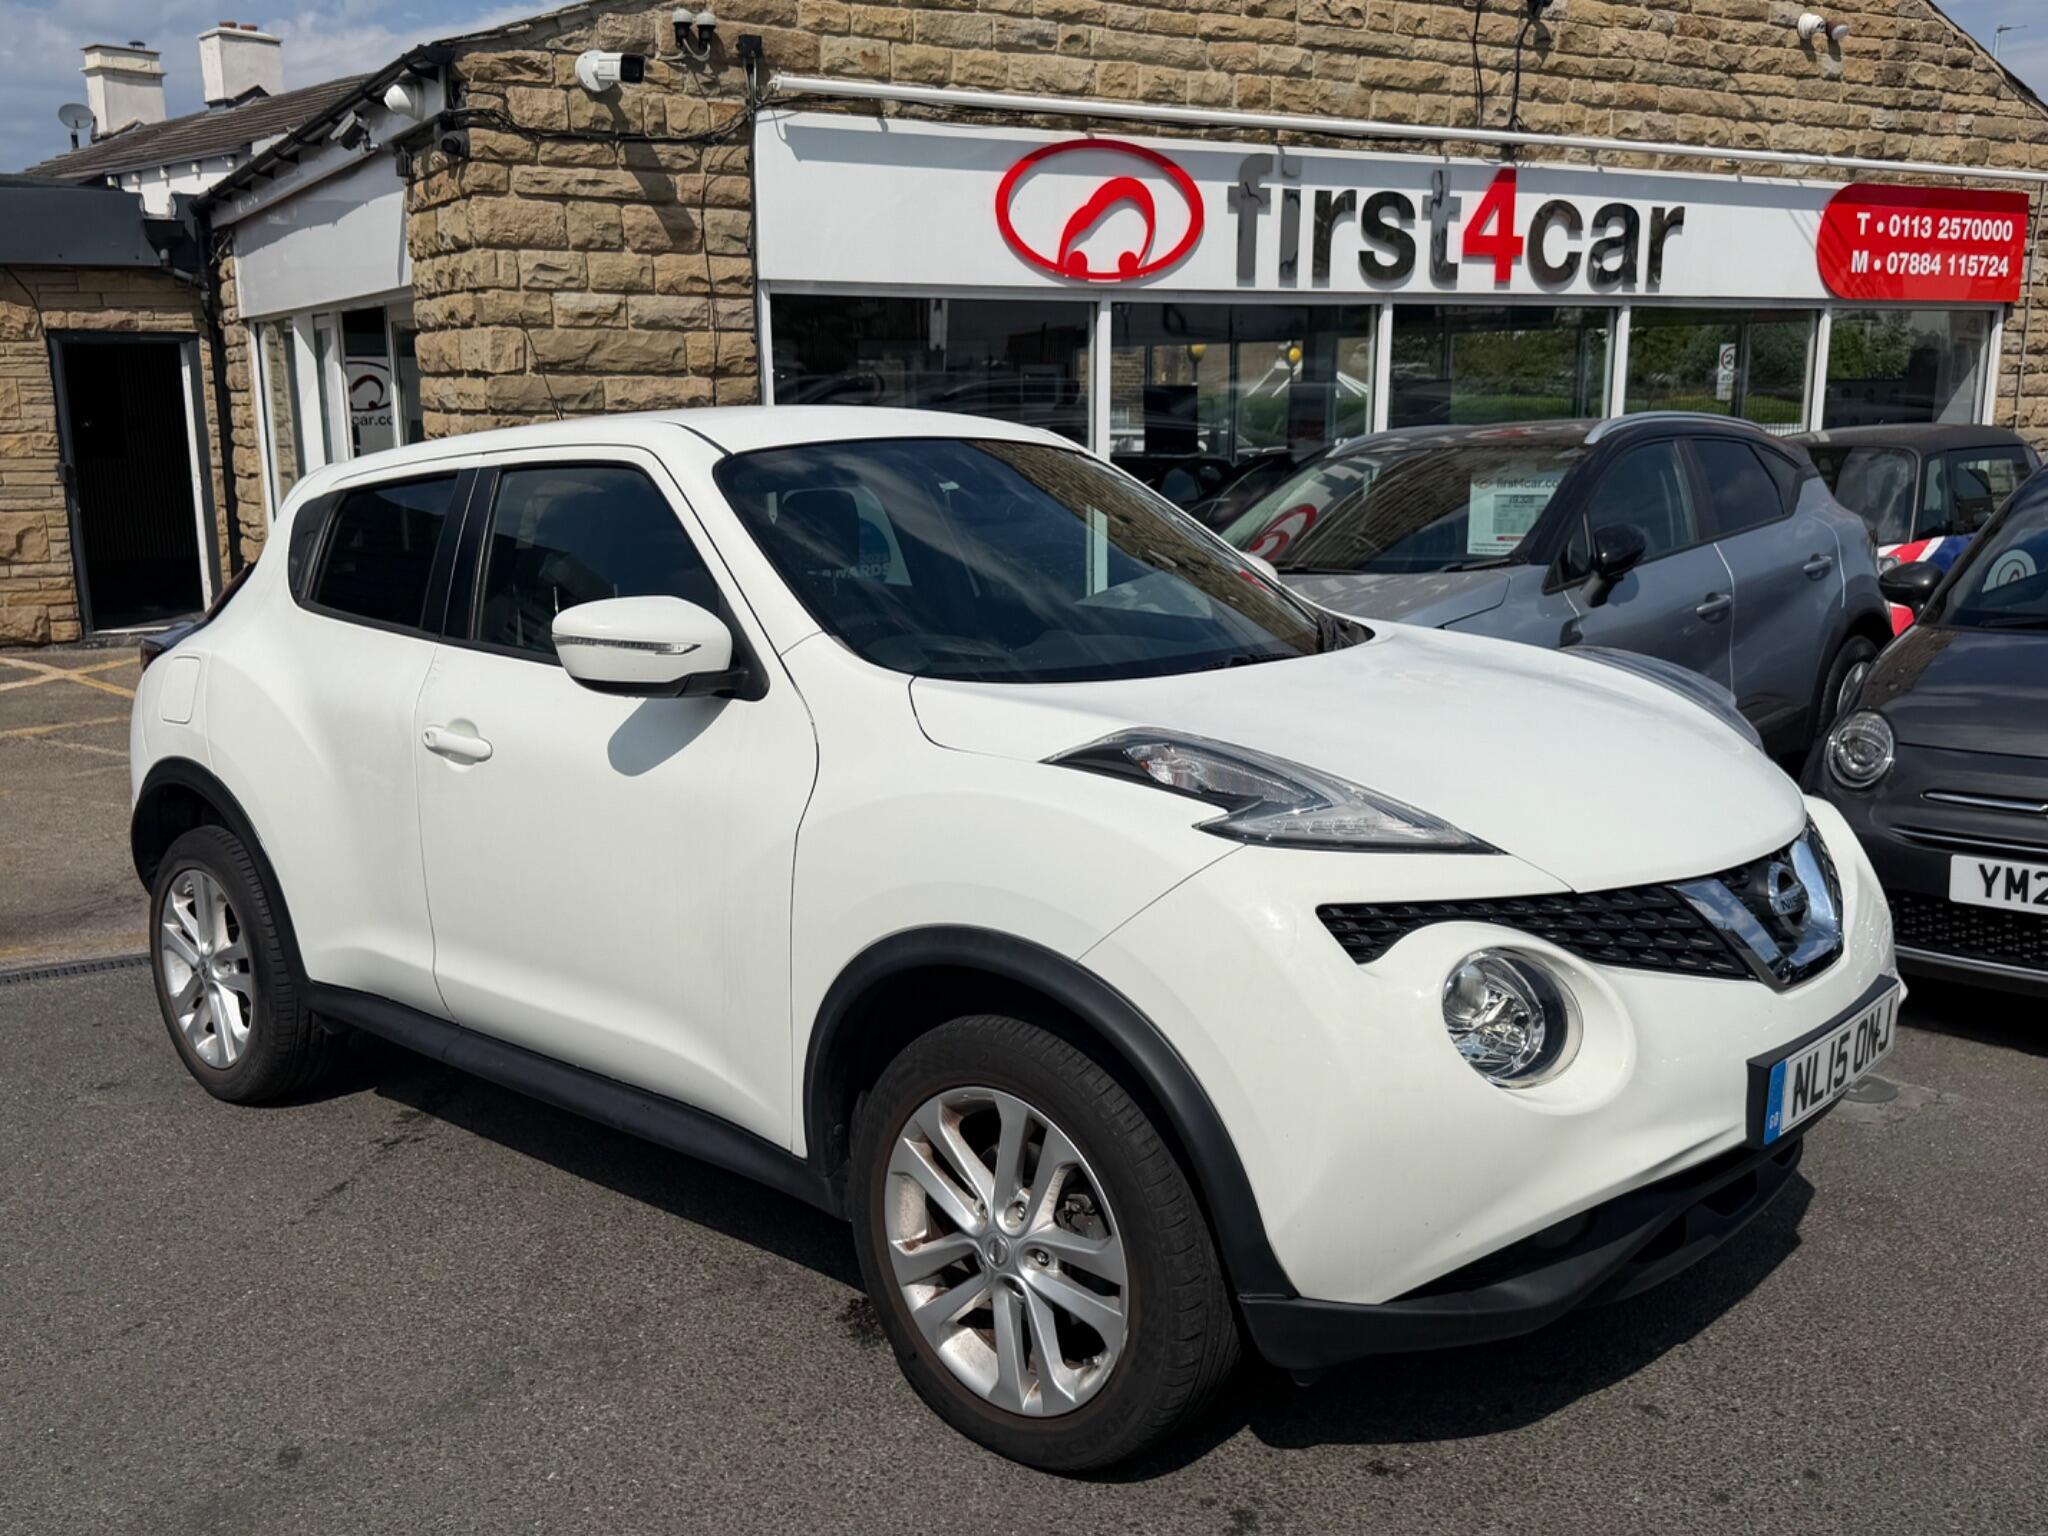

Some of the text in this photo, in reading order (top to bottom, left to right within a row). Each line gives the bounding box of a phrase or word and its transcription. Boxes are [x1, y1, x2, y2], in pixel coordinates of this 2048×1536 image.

[1227, 153, 1685, 289] first4car
[1888, 214, 1932, 239] 0113
[1937, 216, 2013, 242] 2570000
[1886, 252, 1941, 276] 07884
[1947, 254, 2009, 278] 115724
[1791, 1030, 1852, 1119] NL15
